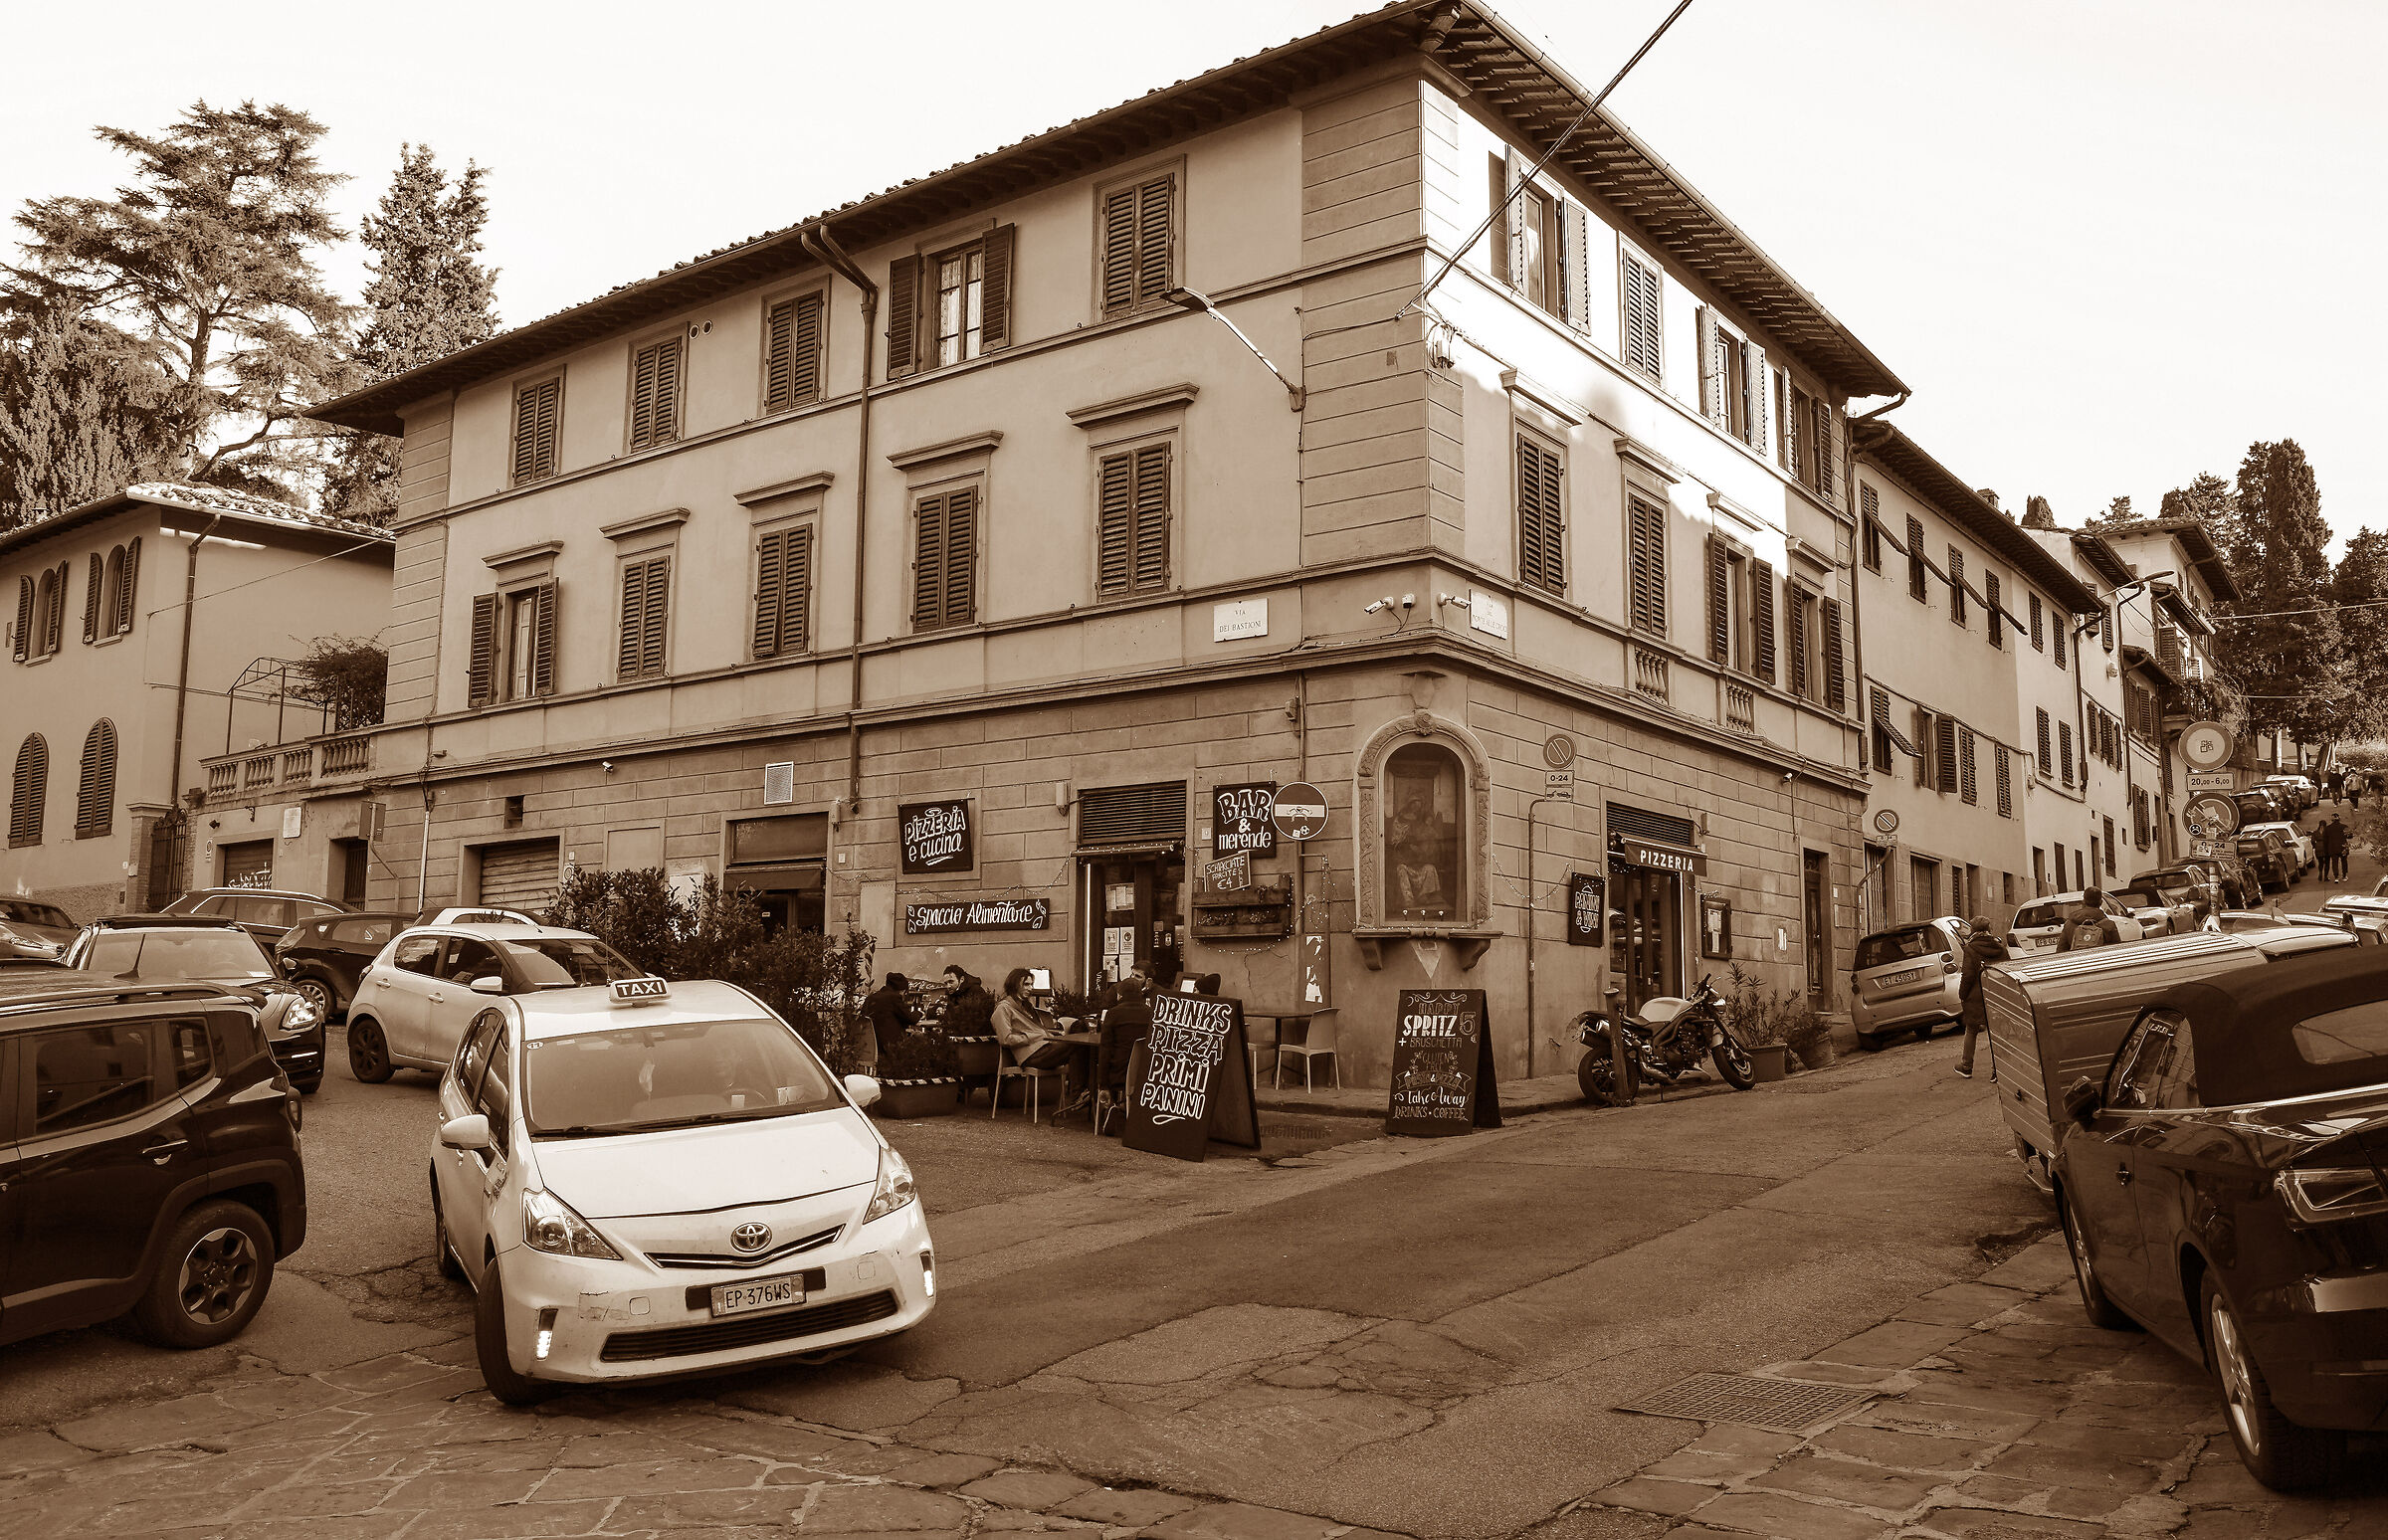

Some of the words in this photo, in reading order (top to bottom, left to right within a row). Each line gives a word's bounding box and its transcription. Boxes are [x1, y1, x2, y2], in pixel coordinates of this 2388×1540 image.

[1219, 624, 1230, 633] DEI
[1232, 620, 1262, 631] BASTIONI
[2191, 777, 2210, 786] 20,00
[1217, 789, 1273, 825] BAR
[904, 805, 966, 846] PIZZERIA
[1218, 825, 1272, 851] merende
[1238, 818, 1252, 834] &
[908, 845, 917, 863] e
[919, 833, 964, 860] cucina
[1640, 849, 1694, 872] PIZZERIA
[915, 906, 964, 930] Spaccio
[965, 900, 1035, 924] Alimentare
[616, 981, 664, 996] TAXI
[1151, 994, 1232, 1035] DRINKS
[1418, 1002, 1461, 1015] HAPPY
[1402, 1015, 1458, 1038] SPRITZ
[1459, 1011, 1477, 1036] 5
[1147, 1023, 1224, 1065] PIZZA
[1409, 1037, 1463, 1049] BRUSCHETTA
[1147, 1053, 1210, 1093] PRIMI
[1430, 1073, 1436, 1082] &
[1140, 1082, 1206, 1120] PANINI
[1393, 1105, 1428, 1118] DRINKS
[1433, 1107, 1466, 1119] COFFEE
[725, 1289, 743, 1308] EP
[746, 1282, 791, 1305] 376WS
